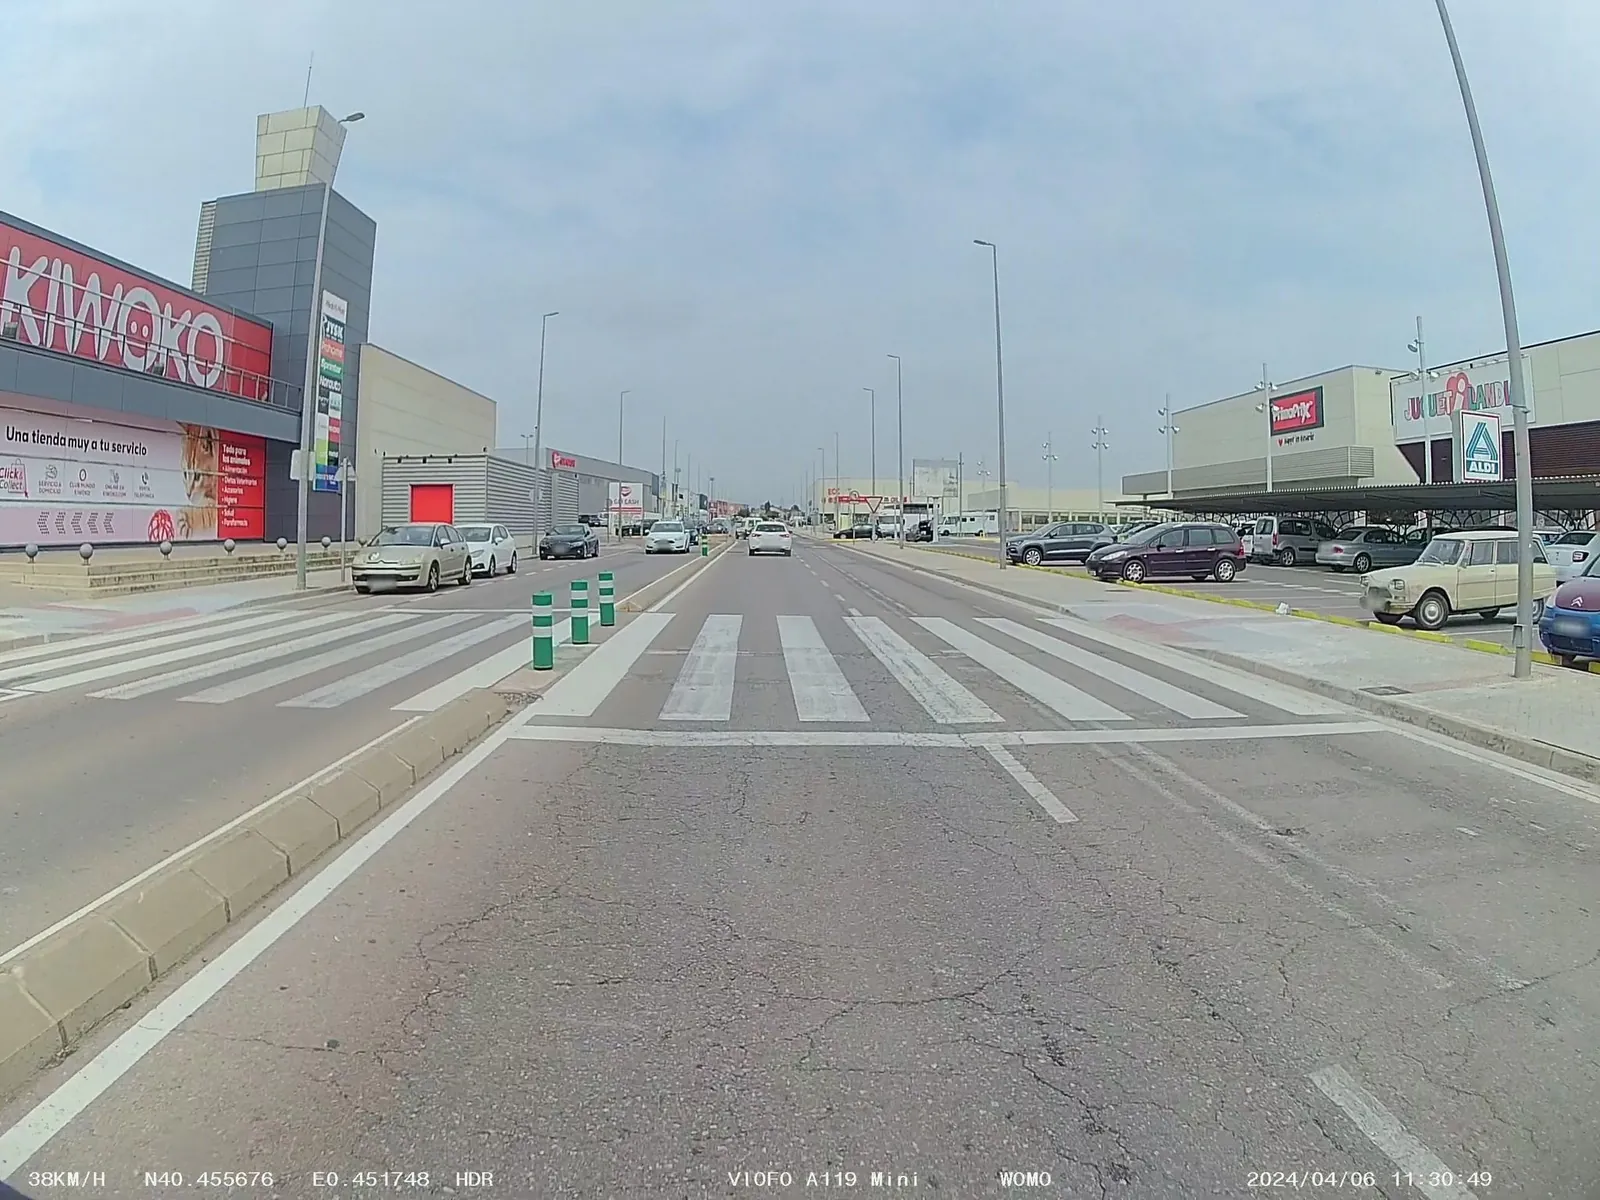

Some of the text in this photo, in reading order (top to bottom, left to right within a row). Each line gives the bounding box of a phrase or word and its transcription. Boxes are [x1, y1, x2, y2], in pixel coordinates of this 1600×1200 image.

[2, 246, 224, 388] KIWOKO
[326, 320, 343, 340] JYSK
[319, 376, 342, 392] Norauto
[6, 426, 147, 456] Una tienda muy a tu servicio
[222, 444, 235, 454] Todo
[1468, 461, 1497, 474] ALDI
